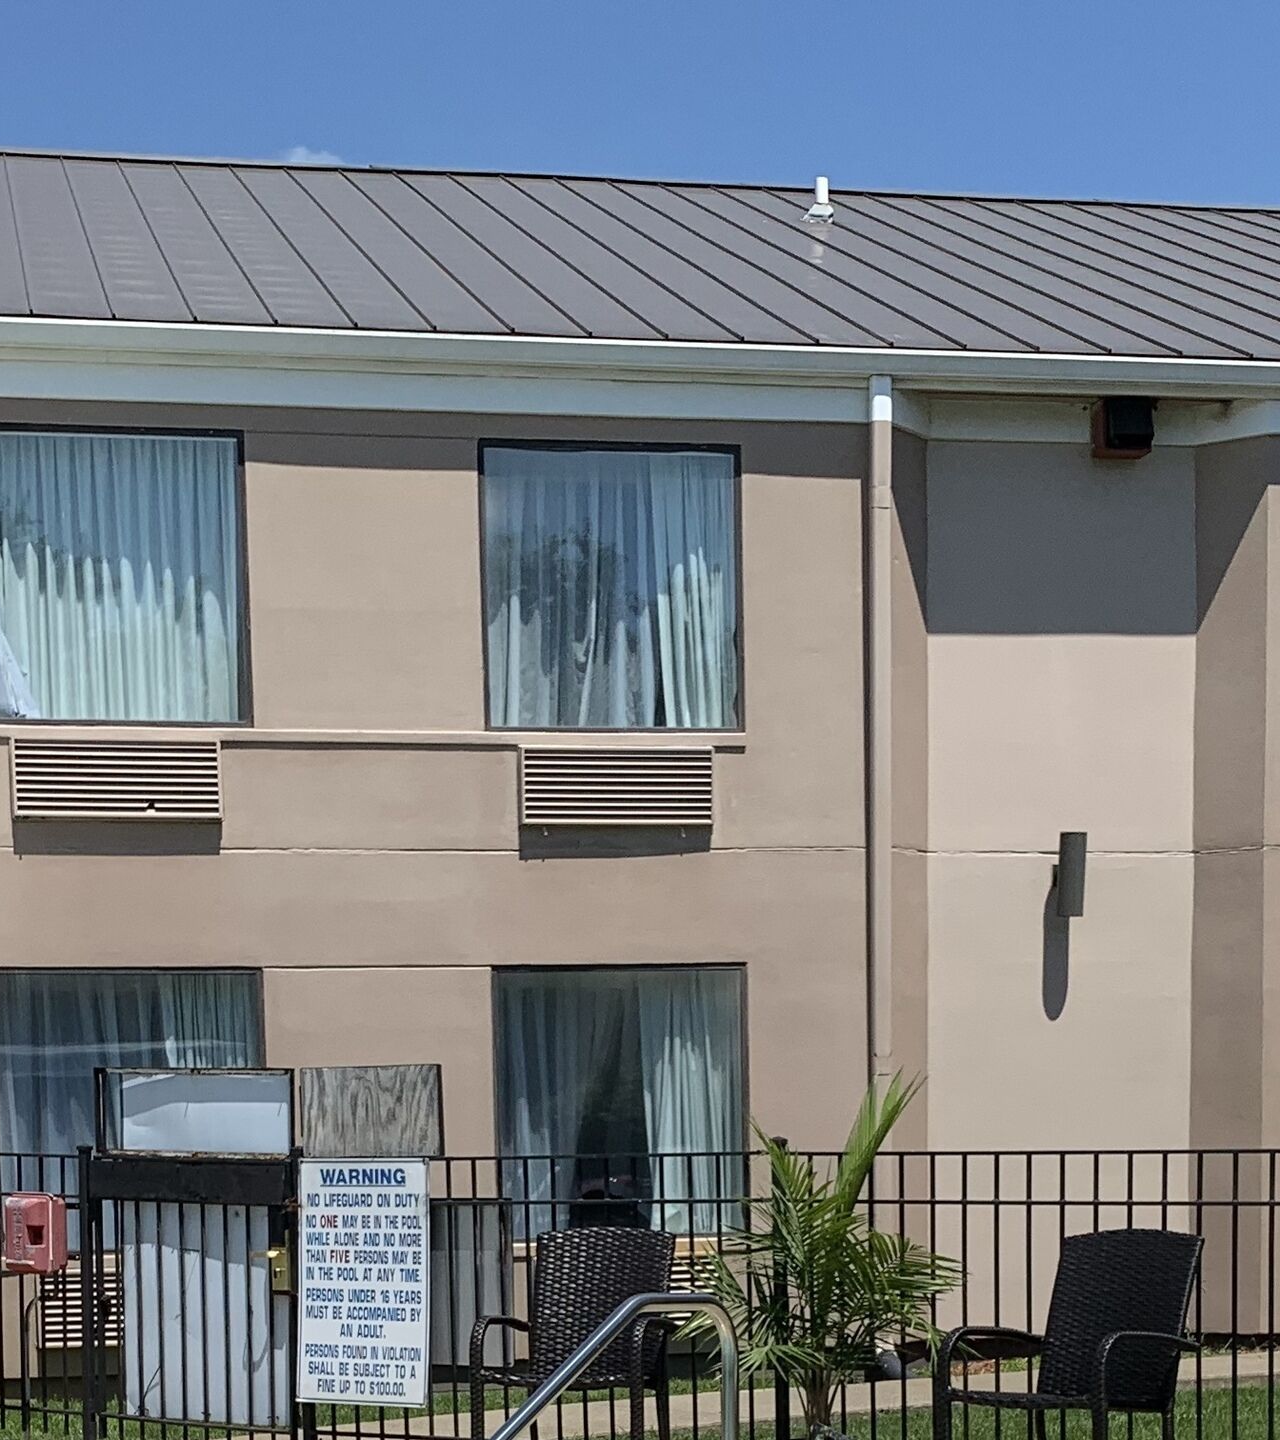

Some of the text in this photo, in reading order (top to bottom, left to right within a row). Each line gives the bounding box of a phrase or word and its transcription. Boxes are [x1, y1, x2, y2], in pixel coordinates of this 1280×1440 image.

[320, 1168, 406, 1185] WARNING
[307, 1193, 420, 1208] NO LIFEGUARD ON DUTY
[306, 1214, 422, 1229] NO ONE MAY BE IN THE POOL
[306, 1232, 422, 1247] WHILE ALONE AND NO MORE
[306, 1249, 422, 1265] THAN FIVE PERSONS MAY BE
[306, 1266, 422, 1283] IN THE POOL AT ANY TIME.
[306, 1288, 422, 1304] PERSONS UNDER 16 YEARS
[306, 1305, 421, 1322] MUST BE ACCOMPANIED BY
[340, 1323, 386, 1339] AN ADULT.
[305, 1343, 422, 1362] PERSONS FOUND IN VIOLATION
[308, 1361, 416, 1379] SHALL BE SUBJECT TO A
[317, 1378, 336, 1392] FINE
[339, 1380, 350, 1393] UP
[355, 1380, 365, 1394] TO
